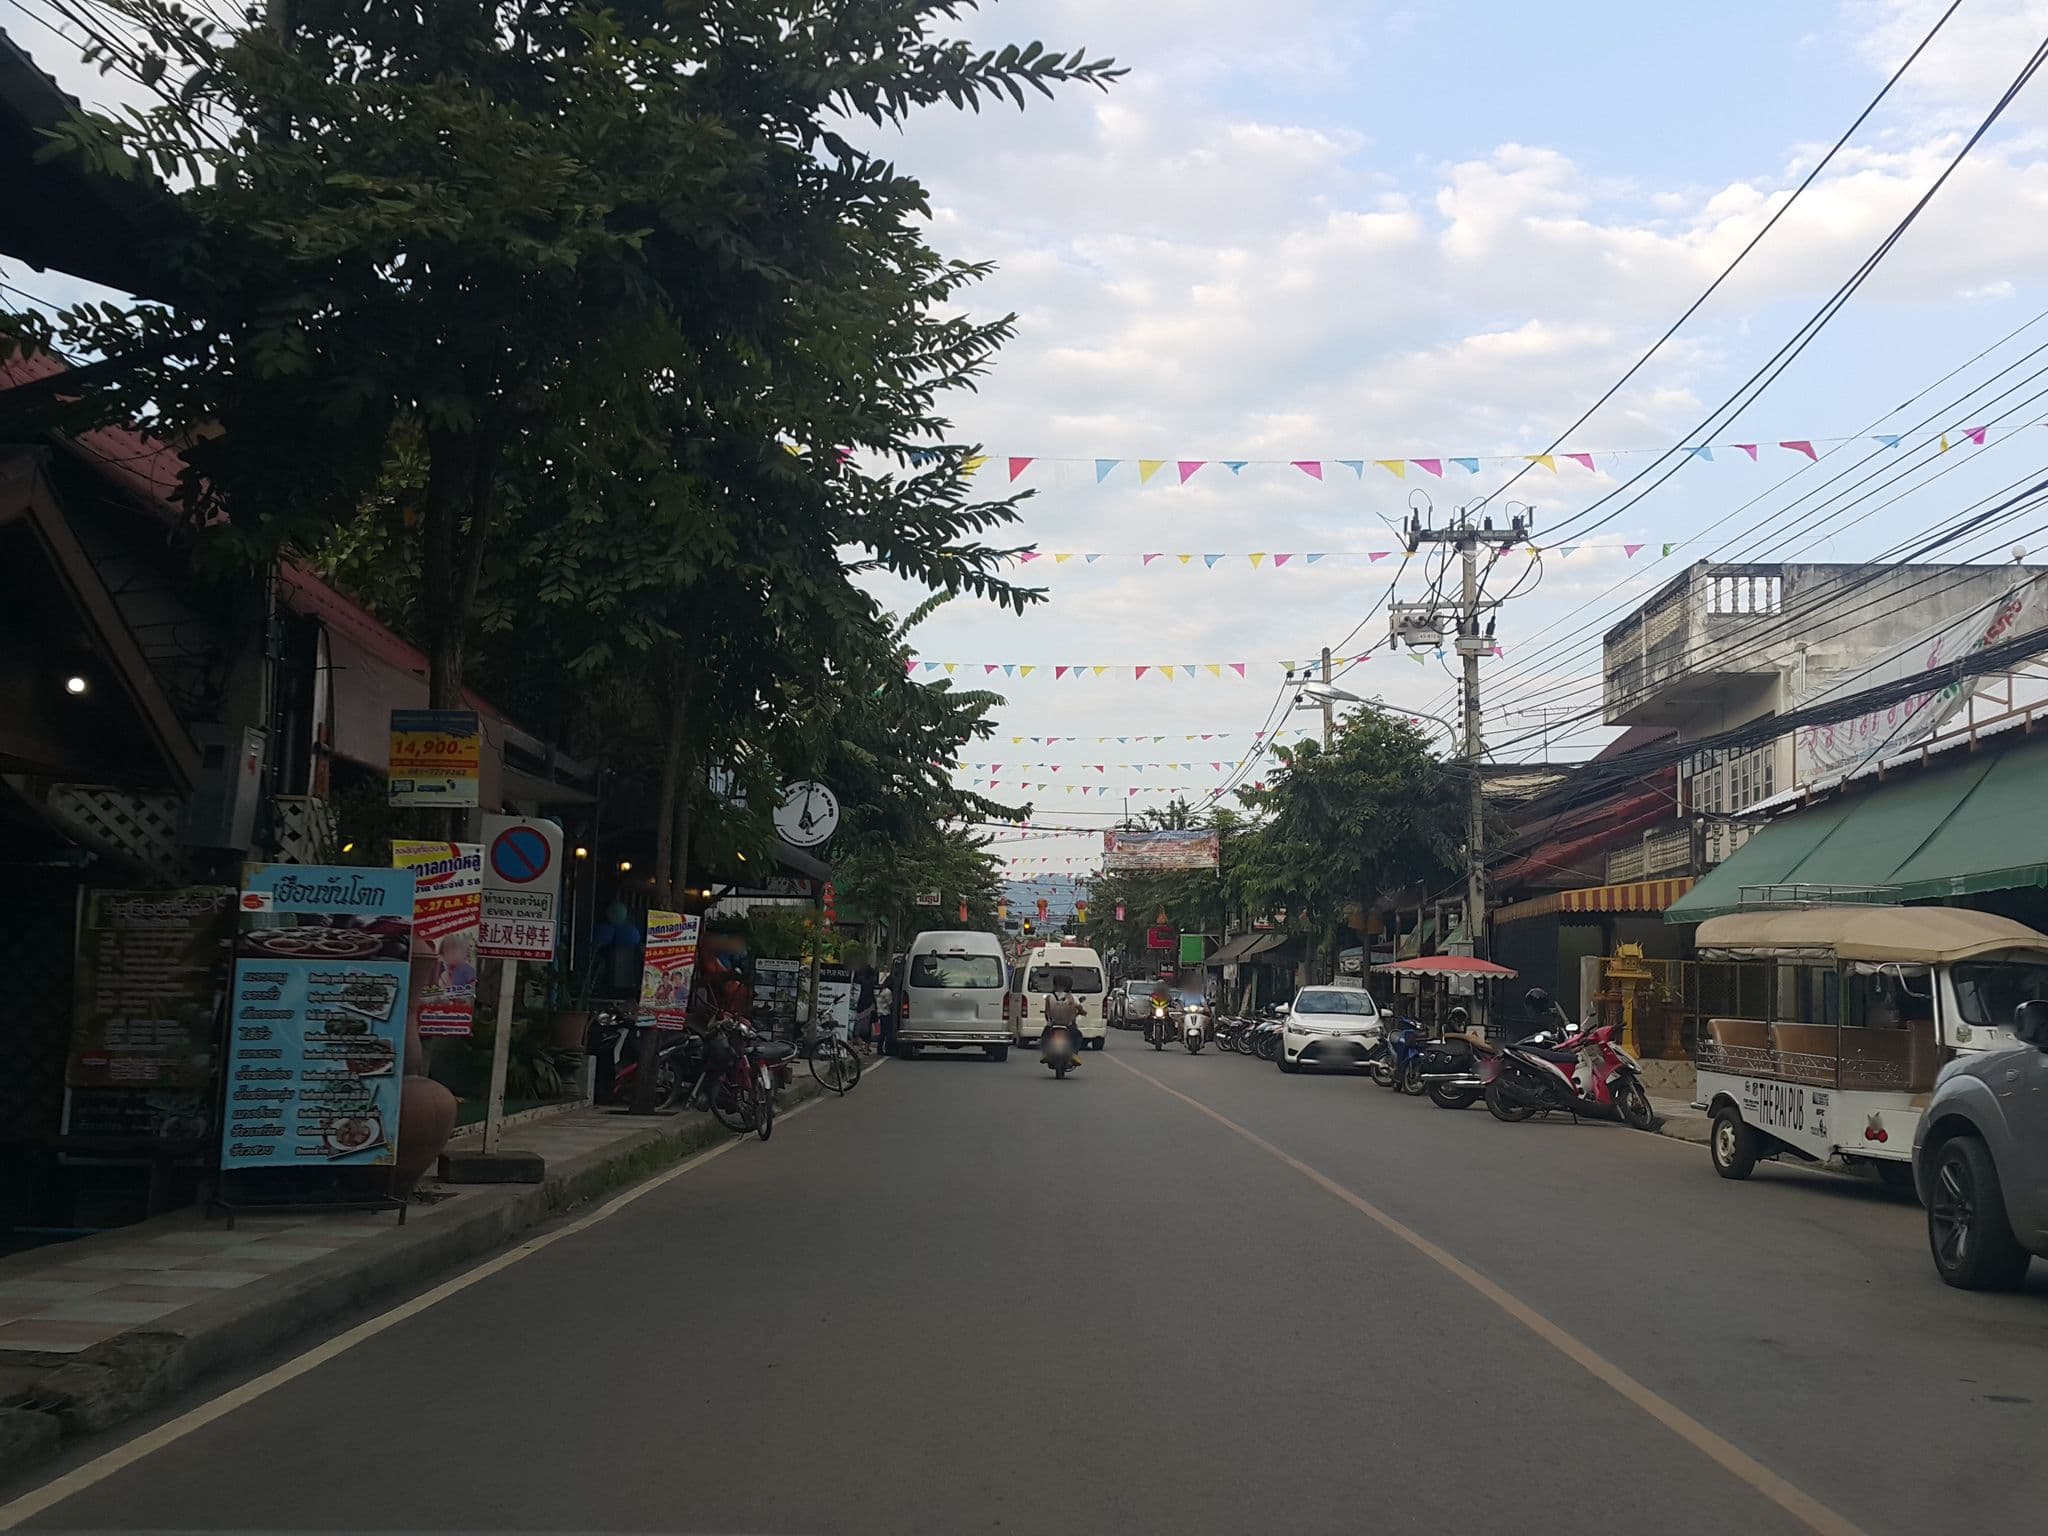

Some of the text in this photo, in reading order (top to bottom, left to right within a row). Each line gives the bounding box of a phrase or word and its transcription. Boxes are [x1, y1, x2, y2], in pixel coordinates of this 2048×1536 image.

[487, 908, 513, 917] EVEN
[517, 910, 543, 919] DAYS
[479, 922, 551, 947] 禁止双号停车
[1759, 1083, 1805, 1131] THE PAI PUB
